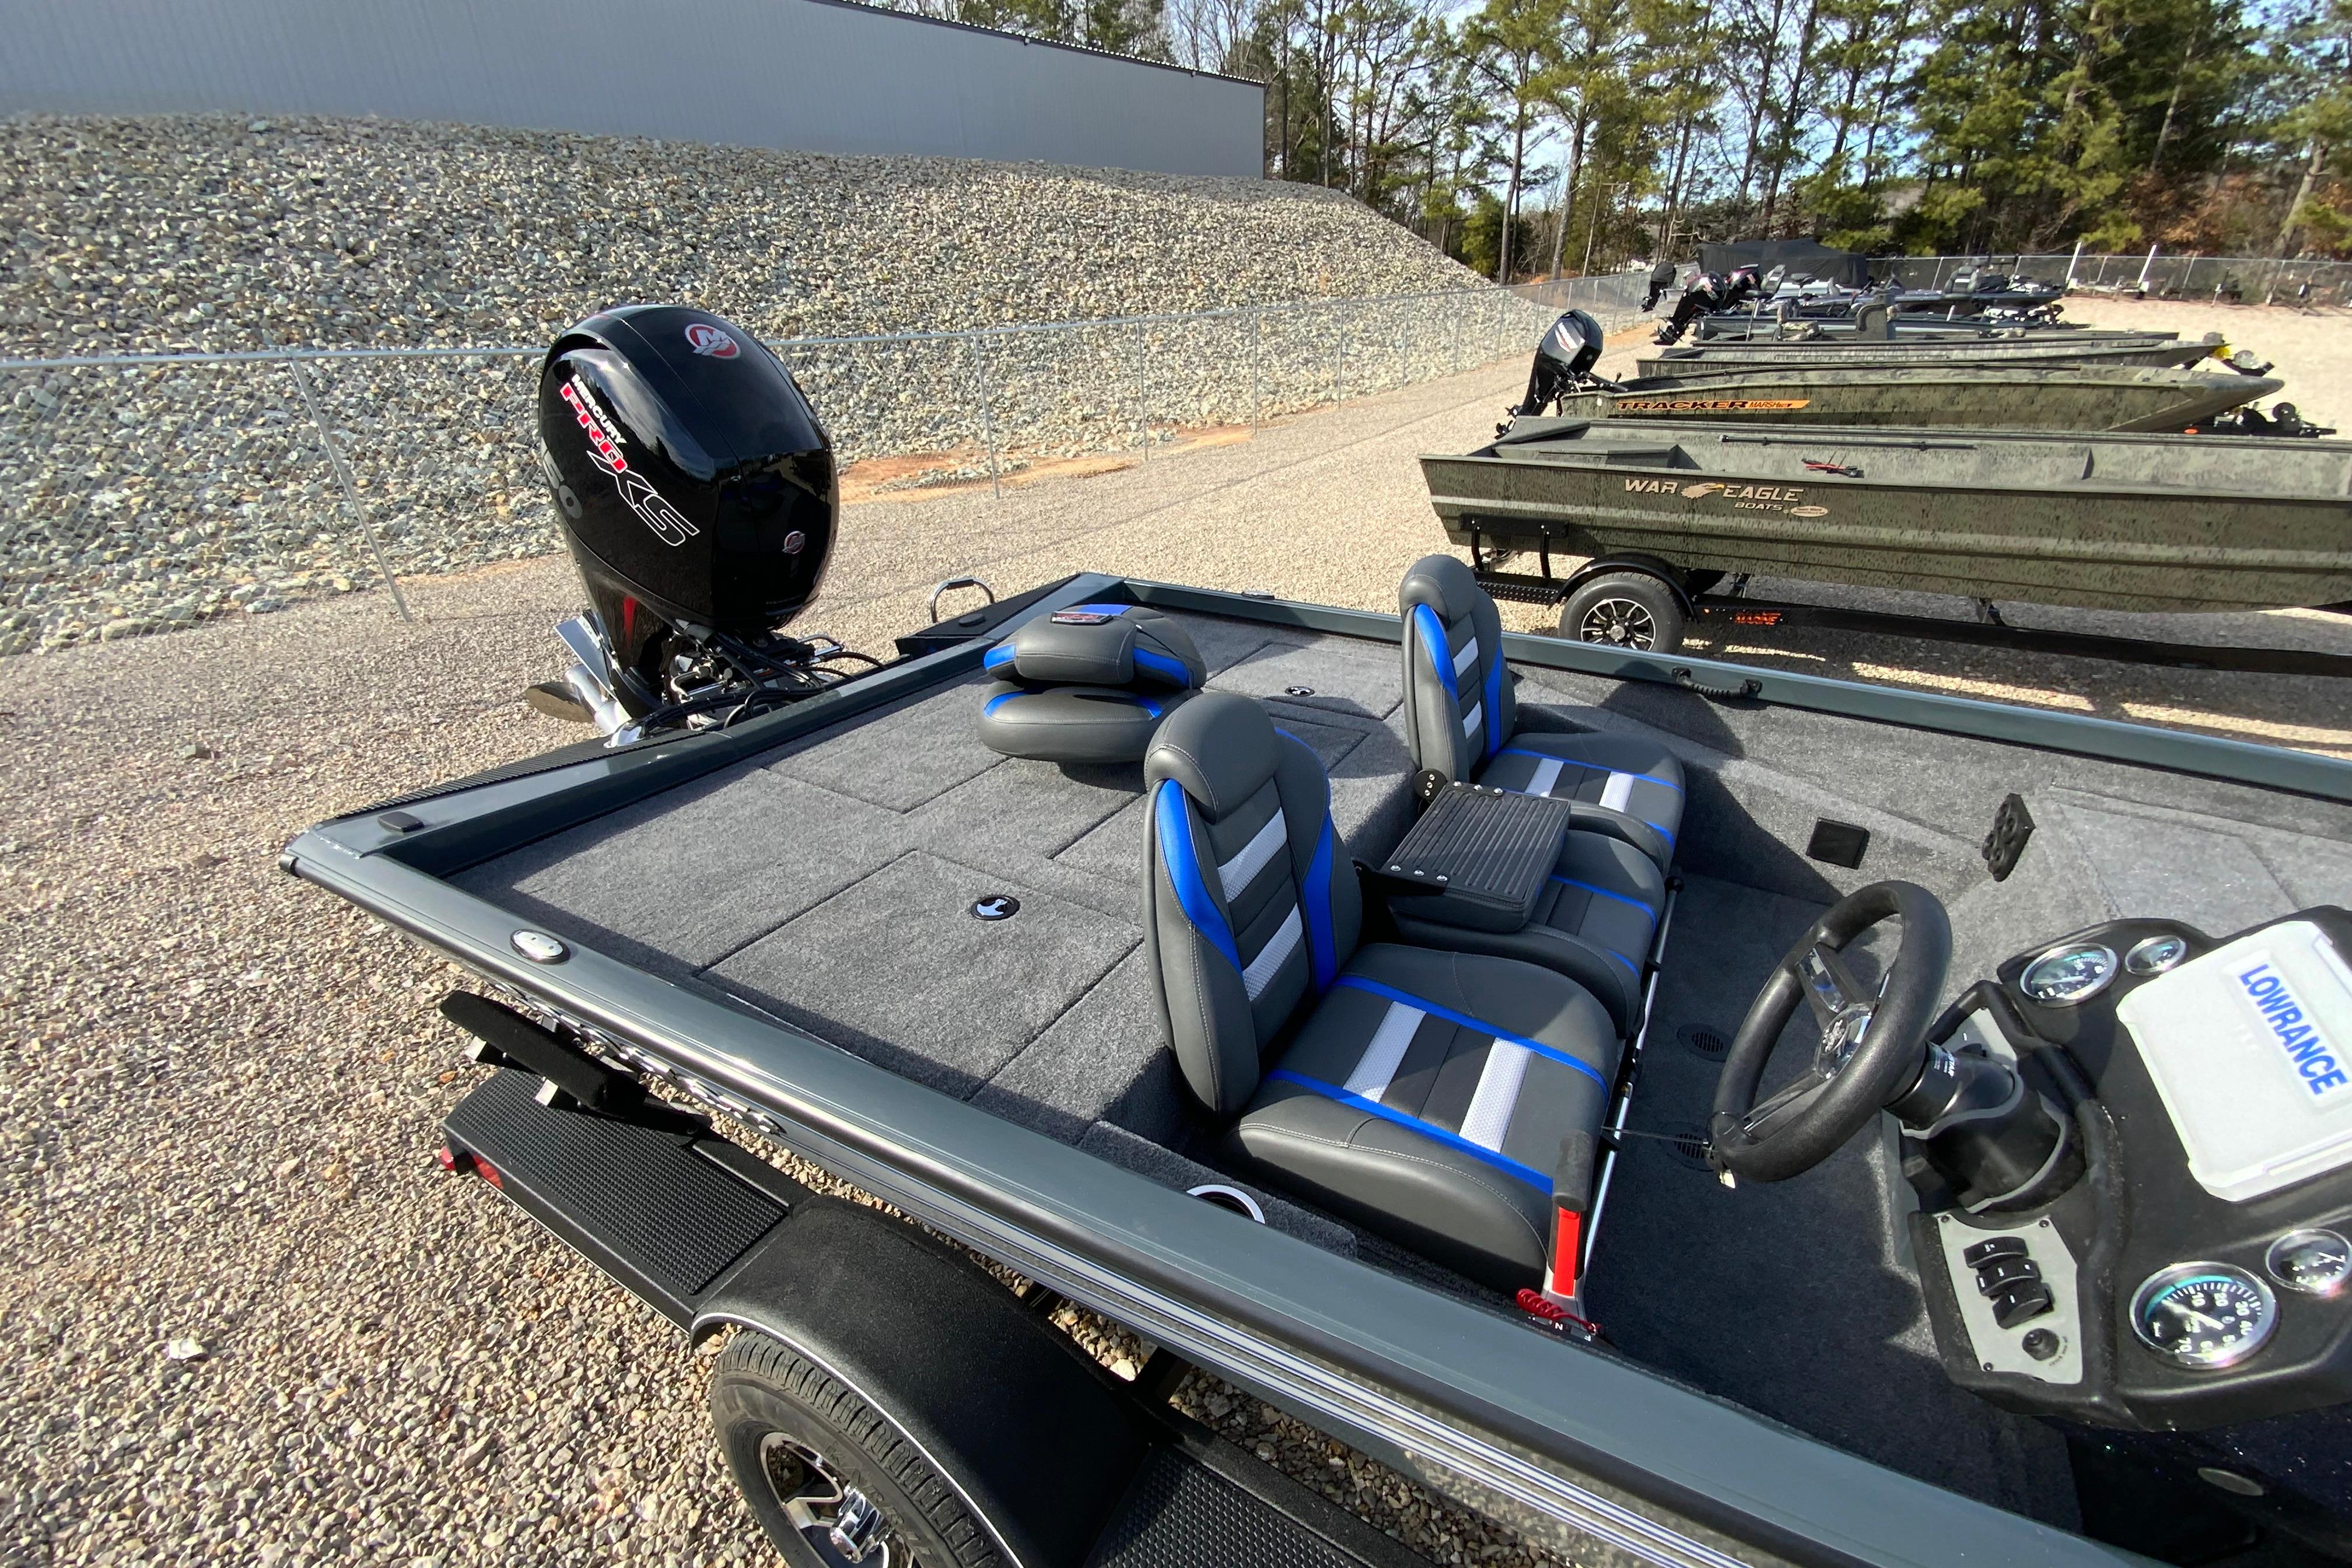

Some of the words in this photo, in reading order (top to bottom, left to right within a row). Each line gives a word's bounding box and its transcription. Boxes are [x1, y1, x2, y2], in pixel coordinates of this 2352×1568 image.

[572, 374, 627, 443] MERCURY
[1617, 401, 1749, 409] TRACKER
[560, 383, 628, 473] PRO
[587, 450, 700, 546] XS
[1625, 479, 1678, 495] WAR
[1723, 485, 1804, 502] EAGLE
[1734, 502, 1783, 511] BOATS
[2239, 964, 2348, 1095] LOWRANCE
[2192, 1292, 2206, 1307] 10
[2213, 1292, 2229, 1307] 20
[2235, 1301, 2250, 1316] 30
[1555, 1322, 1563, 1331] N
[2178, 1337, 2192, 1352] 70
